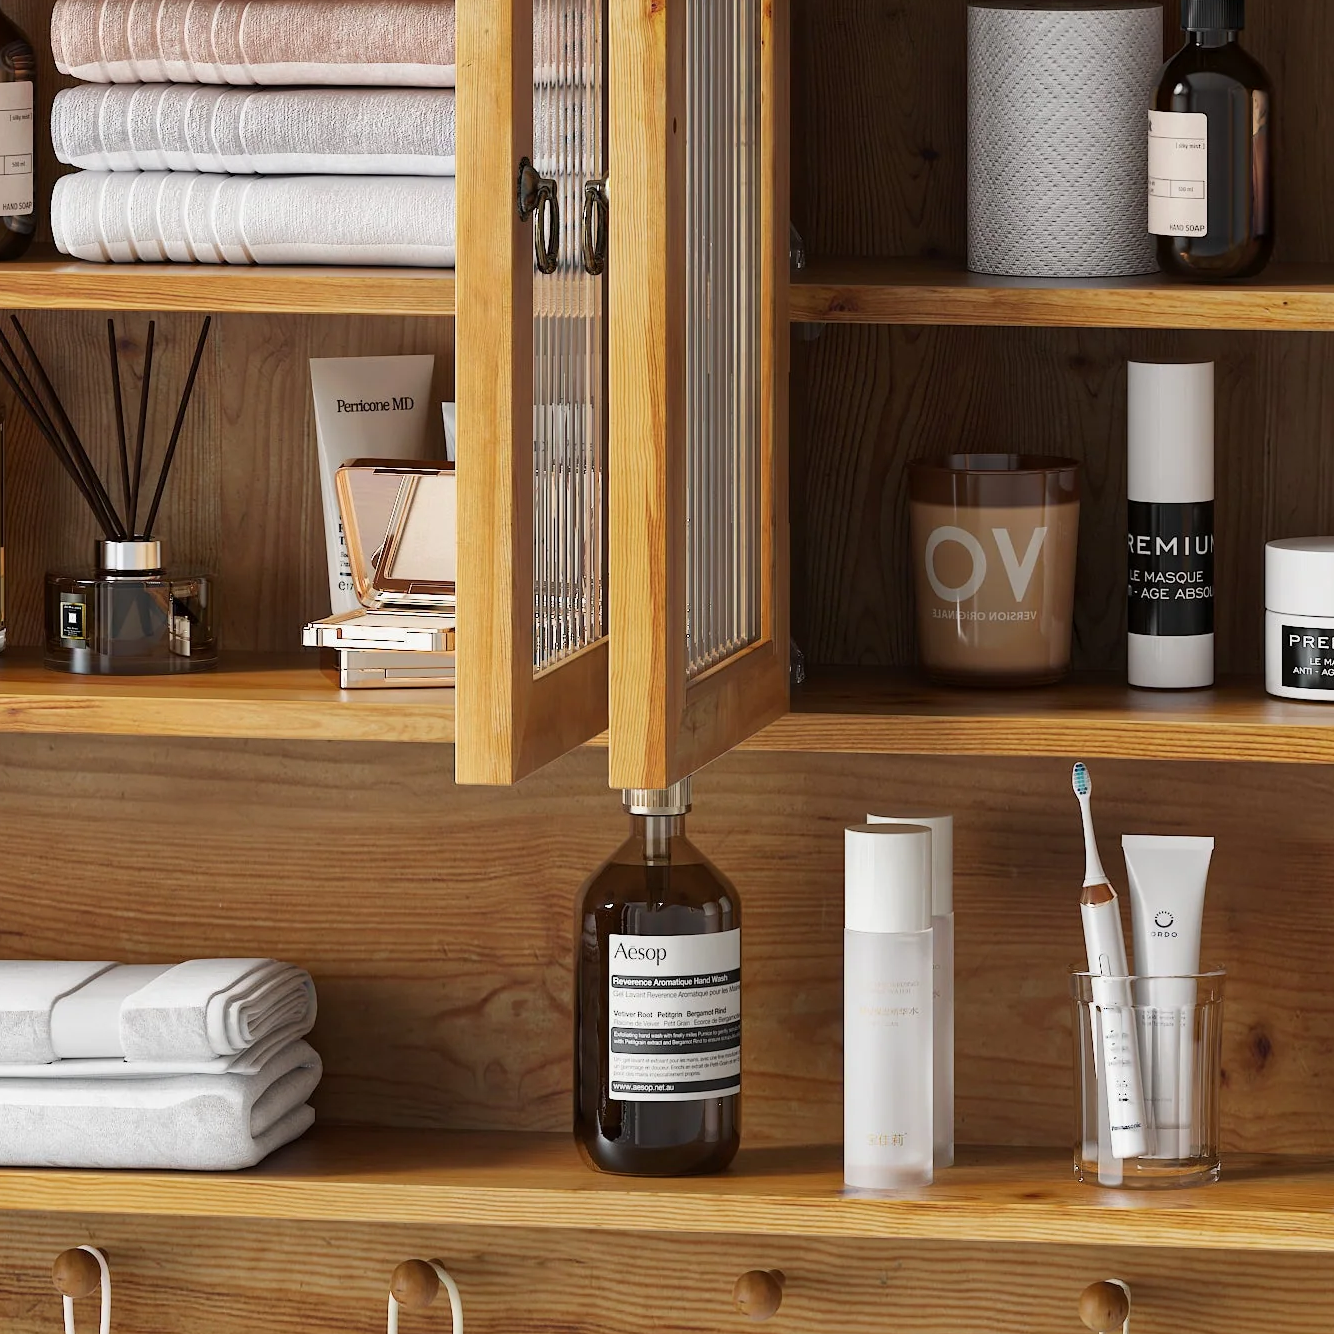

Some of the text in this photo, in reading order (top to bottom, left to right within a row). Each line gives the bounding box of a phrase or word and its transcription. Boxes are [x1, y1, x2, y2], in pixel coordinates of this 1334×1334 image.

[19, 201, 32, 210] SOAP
[1185, 224, 1205, 232] SOAP
[336, 396, 414, 413] Perricone MD
[1130, 569, 1204, 585] LE MASQUE
[1141, 587, 1170, 600] AGE
[1309, 657, 1322, 666] LE
[1292, 666, 1313, 676] ANTI
[653, 977, 692, 987] Aromatique
[693, 976, 711, 984] Hand
[712, 974, 728, 983] Wash
[678, 990, 708, 999] Aromatique
[709, 989, 720, 997] pour
[714, 1007, 727, 1015] Rind
[613, 1083, 675, 1093] www.aesop.net.au
